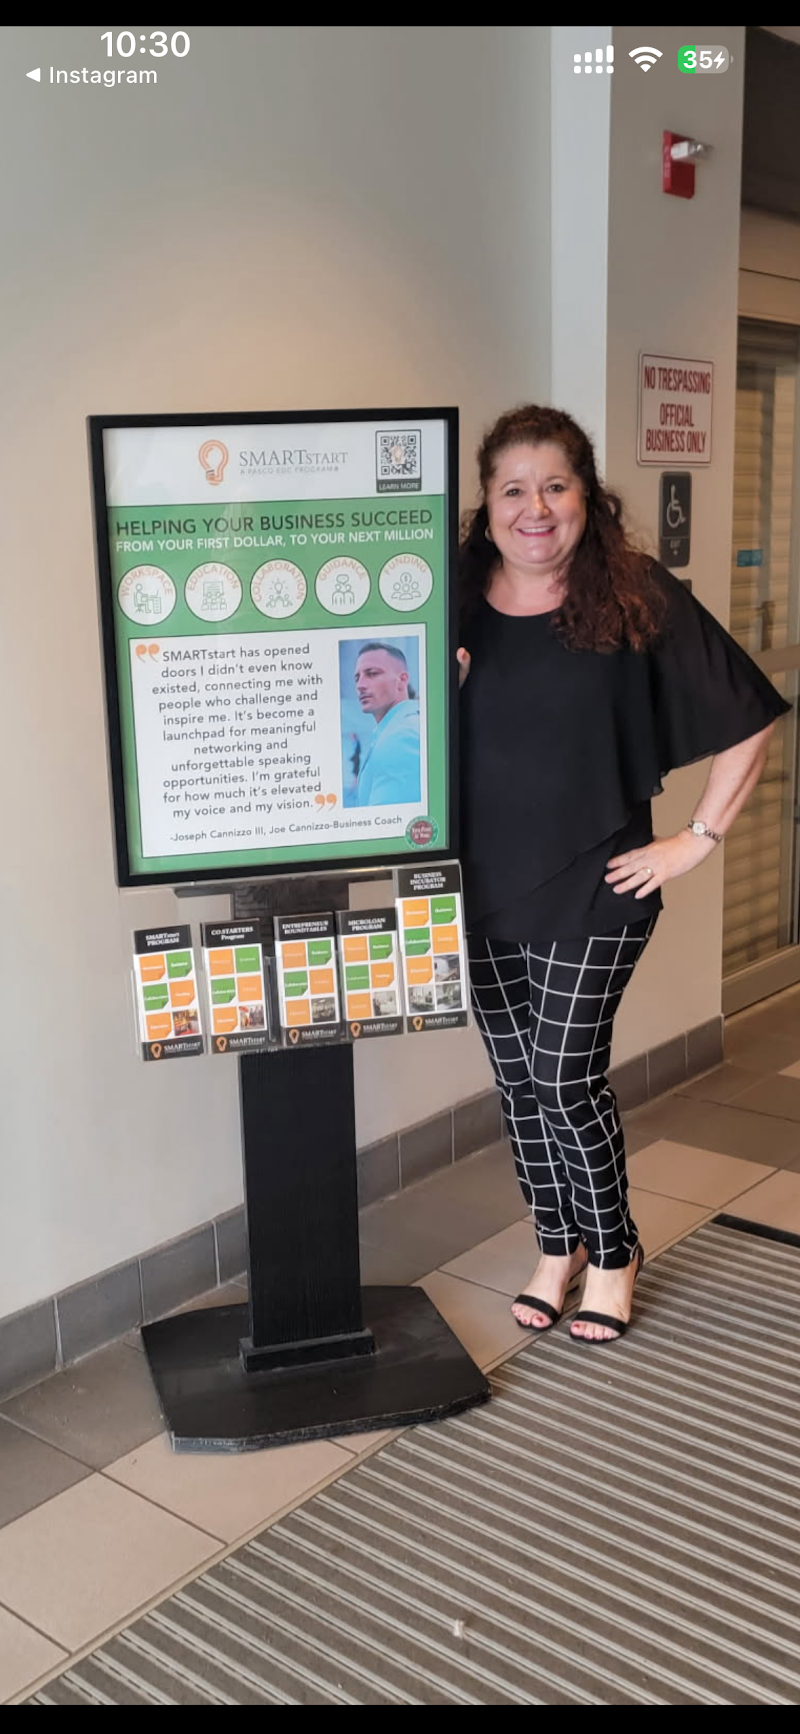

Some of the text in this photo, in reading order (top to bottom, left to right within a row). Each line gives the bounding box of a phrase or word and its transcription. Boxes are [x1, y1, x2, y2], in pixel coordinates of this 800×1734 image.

[644, 367, 710, 394] NO TRESPASSING
[660, 403, 694, 427] OFFICIAL
[646, 429, 706, 453] BUSINESS ONLY
[117, 510, 432, 536] HELPING YOUR BUSINESS SUCCEED
[117, 529, 433, 552] FROM YOUR FIRST DOLLAR, TO YOUR NEXT MILLION
[319, 559, 367, 581] GUIDANCE
[384, 556, 427, 575] FUNDING
[121, 567, 173, 597] WORKSPACE
[188, 564, 239, 591] EDUCATION
[253, 562, 305, 602] COLLABORATION
[163, 643, 310, 662] SMARTstart has opened
[161, 667, 196, 678] doors
[201, 666, 203, 675] I
[248, 664, 276, 673] even
[280, 661, 313, 671] know
[152, 674, 323, 694] existed, connecting me with
[159, 690, 318, 713] people who challenge and
[164, 715, 204, 727] inspire
[209, 713, 230, 723] me.
[257, 708, 304, 719] become
[163, 722, 316, 742] launchpad for meaningful
[194, 739, 287, 755] networking and
[172, 753, 310, 773] unforgettable speaking
[163, 773, 248, 789] opportunities.
[275, 767, 320, 782] grateful
[163, 793, 180, 803] for
[185, 790, 209, 801] how
[214, 788, 245, 799] much
[271, 782, 321, 795] elevated
[173, 799, 313, 820] my voice and my vision.
[171, 816, 402, 842] -Joseph Cannizzo III, Joe Cannizzo-Business Coach
[410, 877, 446, 885] INCUBATOR
[282, 920, 328, 929] ENTREPRENEUR
[284, 926, 327, 934] ROUNDTABLES
[348, 918, 386, 926] MICROLOAN
[147, 938, 179, 946] PROGRAM
